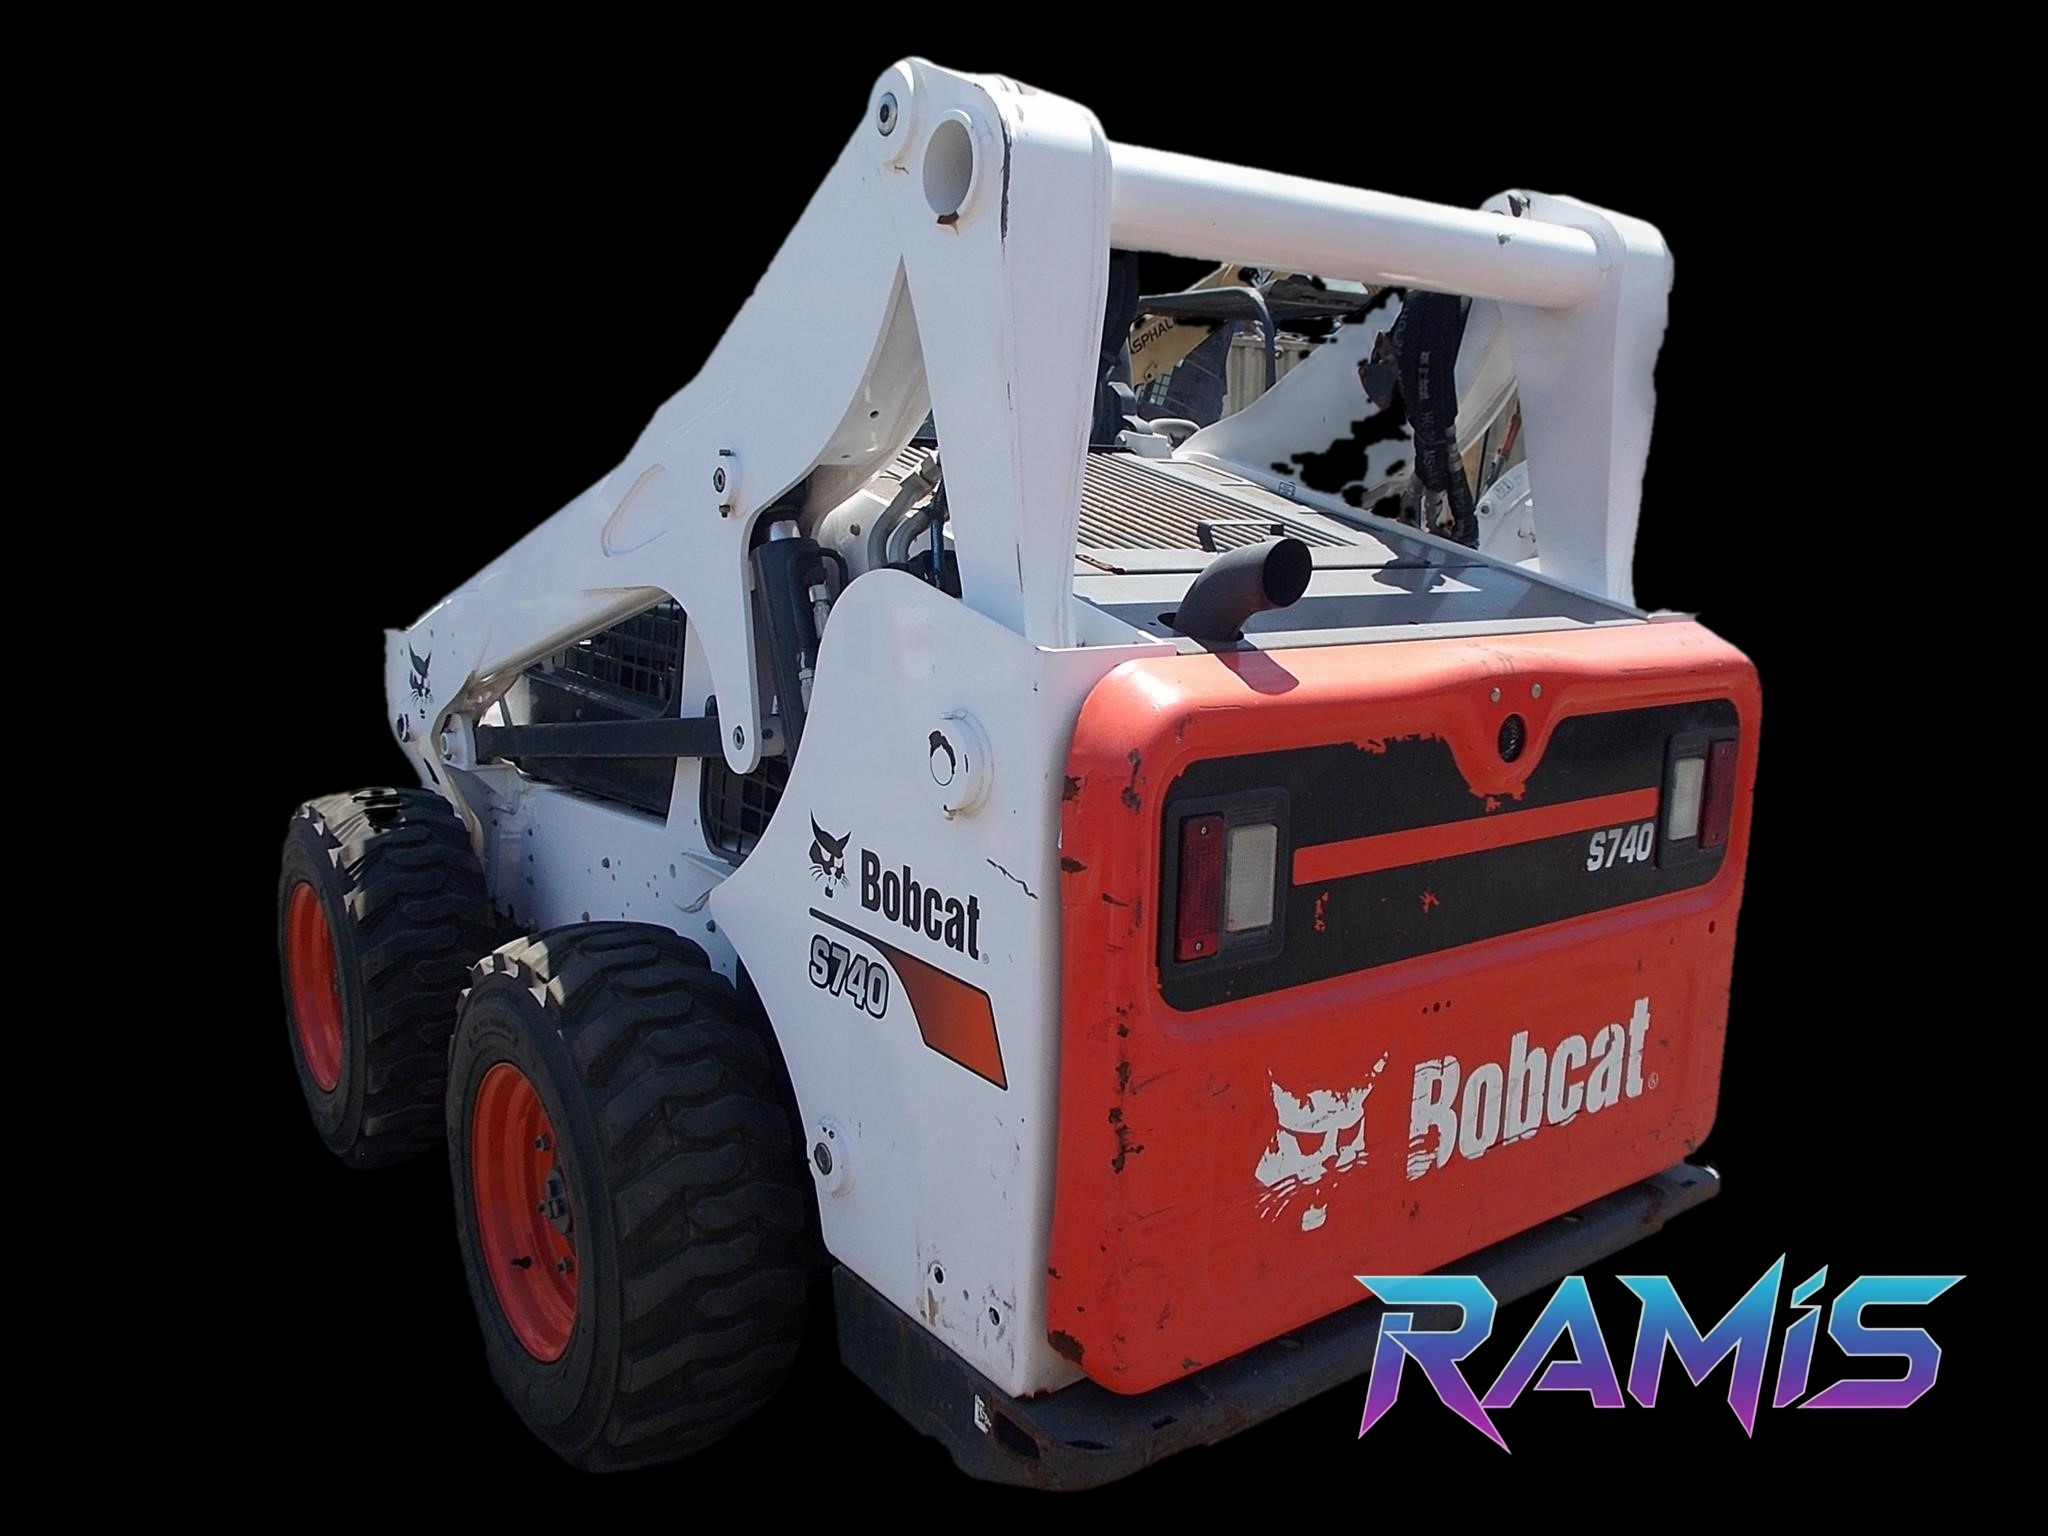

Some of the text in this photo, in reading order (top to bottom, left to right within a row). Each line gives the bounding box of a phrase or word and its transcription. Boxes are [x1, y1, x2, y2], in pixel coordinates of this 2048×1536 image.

[1130, 317, 1178, 355] SPHAL
[1586, 822, 1654, 872] S740
[861, 847, 980, 961] Bobcat
[809, 933, 890, 1020] S740
[1406, 997, 1652, 1182] Bobcat
